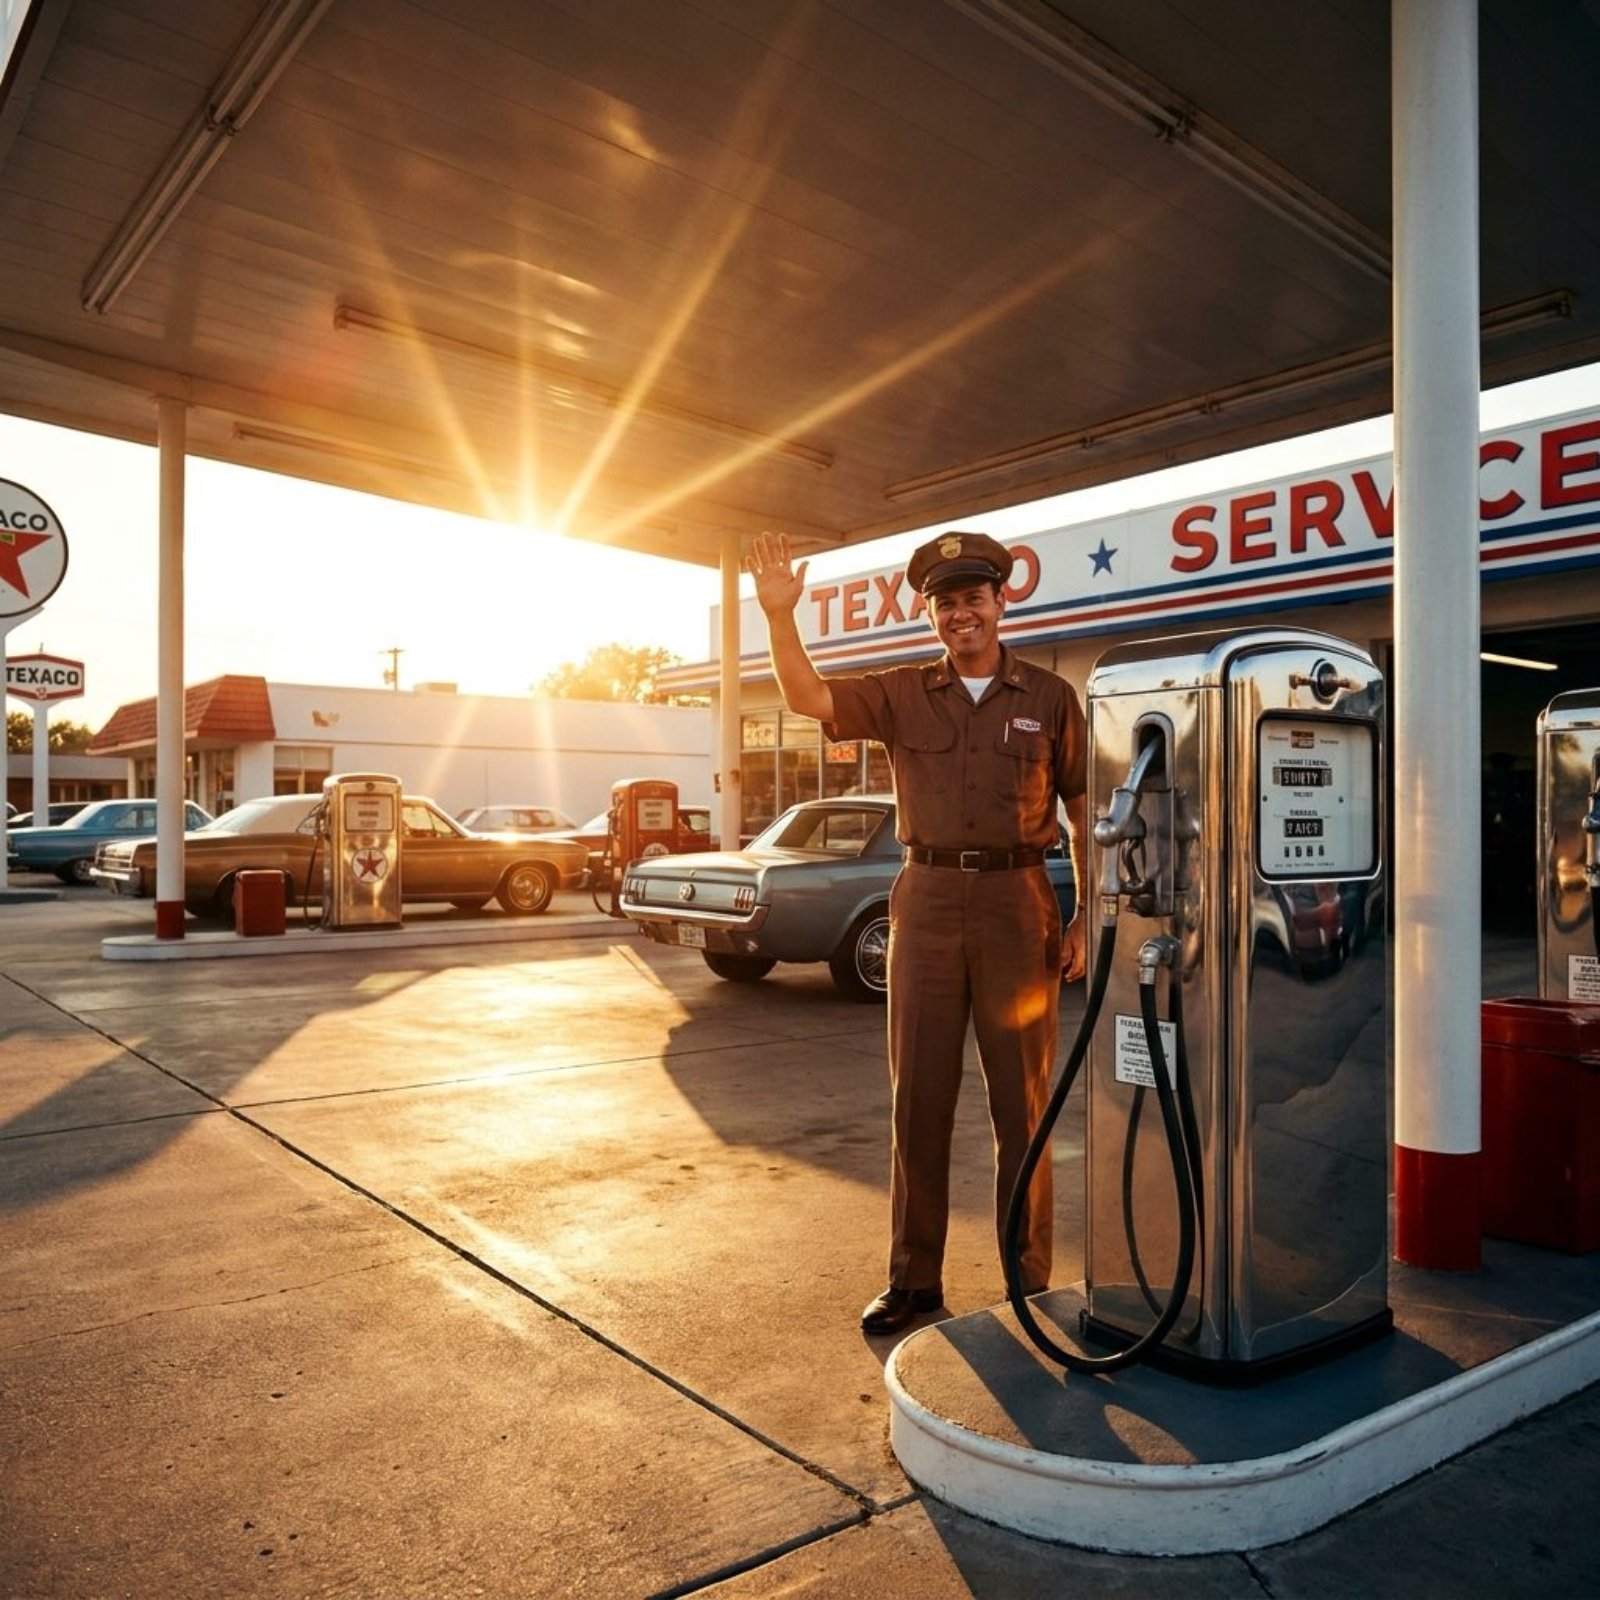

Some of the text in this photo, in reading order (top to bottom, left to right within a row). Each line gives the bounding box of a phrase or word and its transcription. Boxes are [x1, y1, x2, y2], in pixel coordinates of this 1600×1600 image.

[810, 419, 1600, 637] TEXO SERVCE
[6, 666, 79, 686] TEXACO
